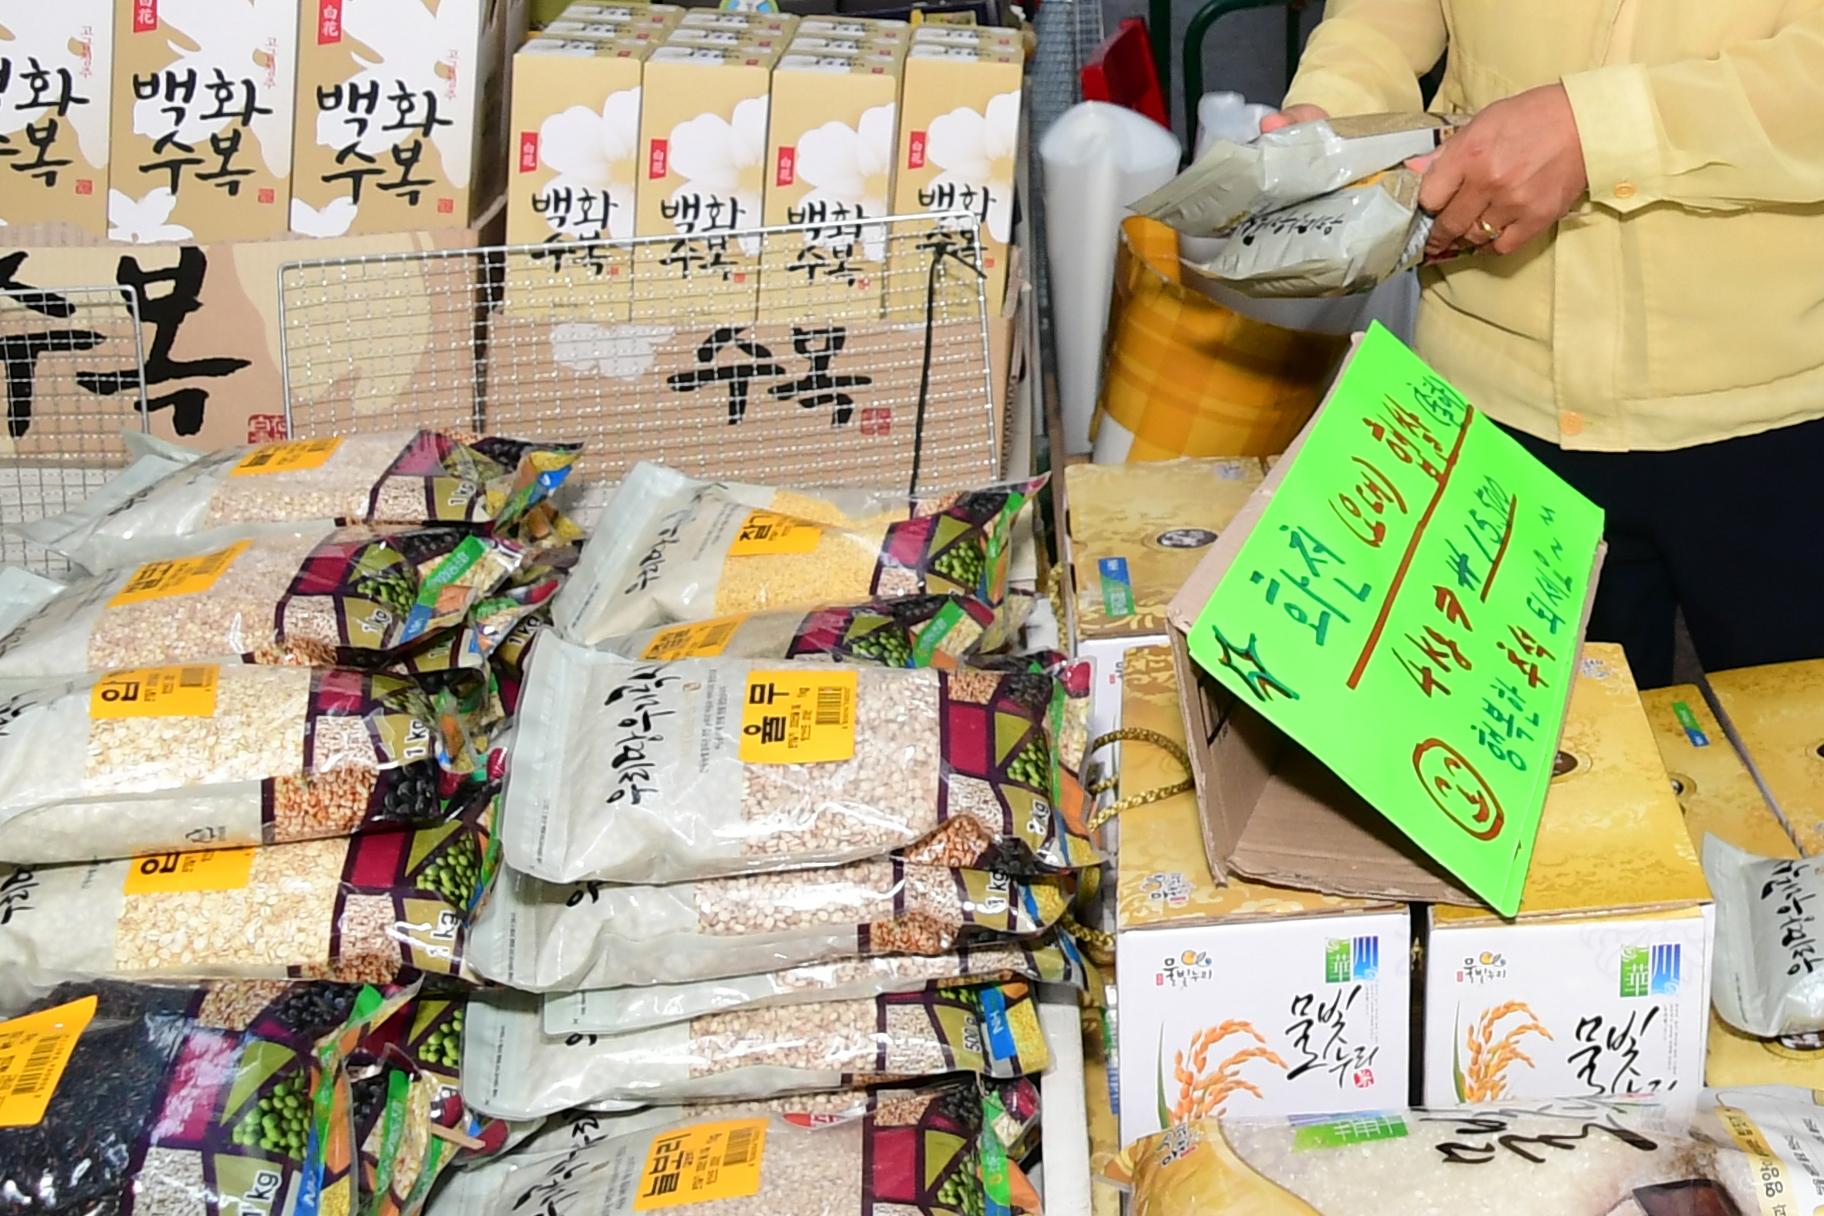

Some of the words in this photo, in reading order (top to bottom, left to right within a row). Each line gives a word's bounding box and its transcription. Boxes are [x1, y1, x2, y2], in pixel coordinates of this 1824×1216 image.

[0, 56, 90, 117] 화
[132, 67, 274, 127] 백화
[316, 79, 454, 138] 백화
[138, 129, 257, 197] 수복
[321, 140, 436, 206] 수복
[532, 187, 619, 230] 백화
[661, 194, 746, 234] 백화
[787, 200, 871, 241] 백화
[531, 231, 612, 276] 수복
[659, 236, 738, 281] 수복
[786, 244, 863, 287] 수복
[666, 326, 873, 427] 수복
[1250, 524, 1372, 646] 화천
[1329, 456, 1408, 548] (오대)
[1392, 625, 1473, 698] 4kg
[1497, 624, 1556, 688] 추석
[743, 682, 791, 745] 율무
[1471, 677, 1540, 771] 행복한
[1162, 957, 1213, 990] 물빛누리
[642, 1132, 691, 1198] 늘보리
